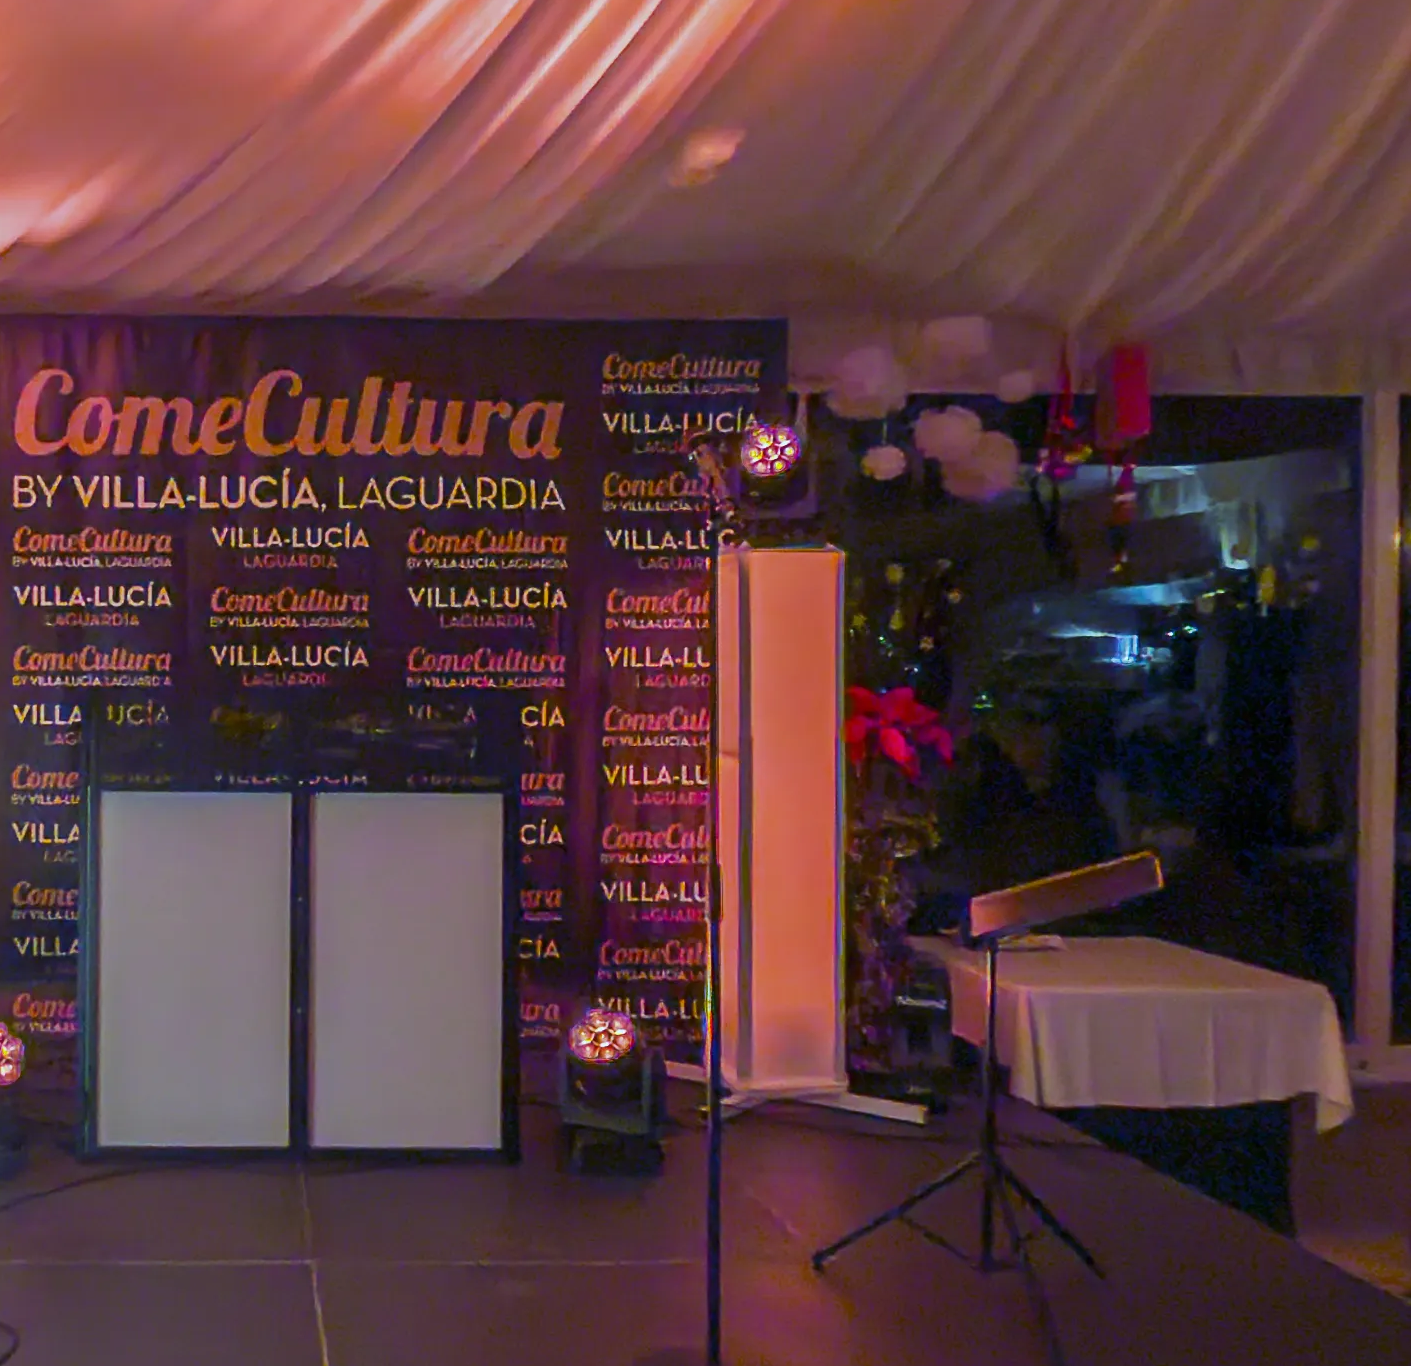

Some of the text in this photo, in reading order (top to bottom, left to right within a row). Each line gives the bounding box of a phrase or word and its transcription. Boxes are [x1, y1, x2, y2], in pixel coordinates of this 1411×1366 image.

[602, 353, 762, 380] ComeCultura
[13, 368, 566, 461] ComeCultura
[12, 468, 566, 514] BY VILLA-LUCÍA, LAGUARDIA
[13, 525, 173, 552] ComeCultura
[211, 521, 370, 548] VILLA-LUCÍA
[407, 527, 567, 554] ComeCultura
[243, 554, 338, 568] LAGUARDIA
[13, 581, 172, 607] VILLA-LUCÍA
[210, 586, 370, 613] ComeCultura
[407, 582, 568, 609] VILLA-LUCÍA
[13, 645, 172, 672] ComeCultura
[210, 641, 370, 667] VILLA-LUCÍA
[407, 646, 566, 673] ComeCultura
